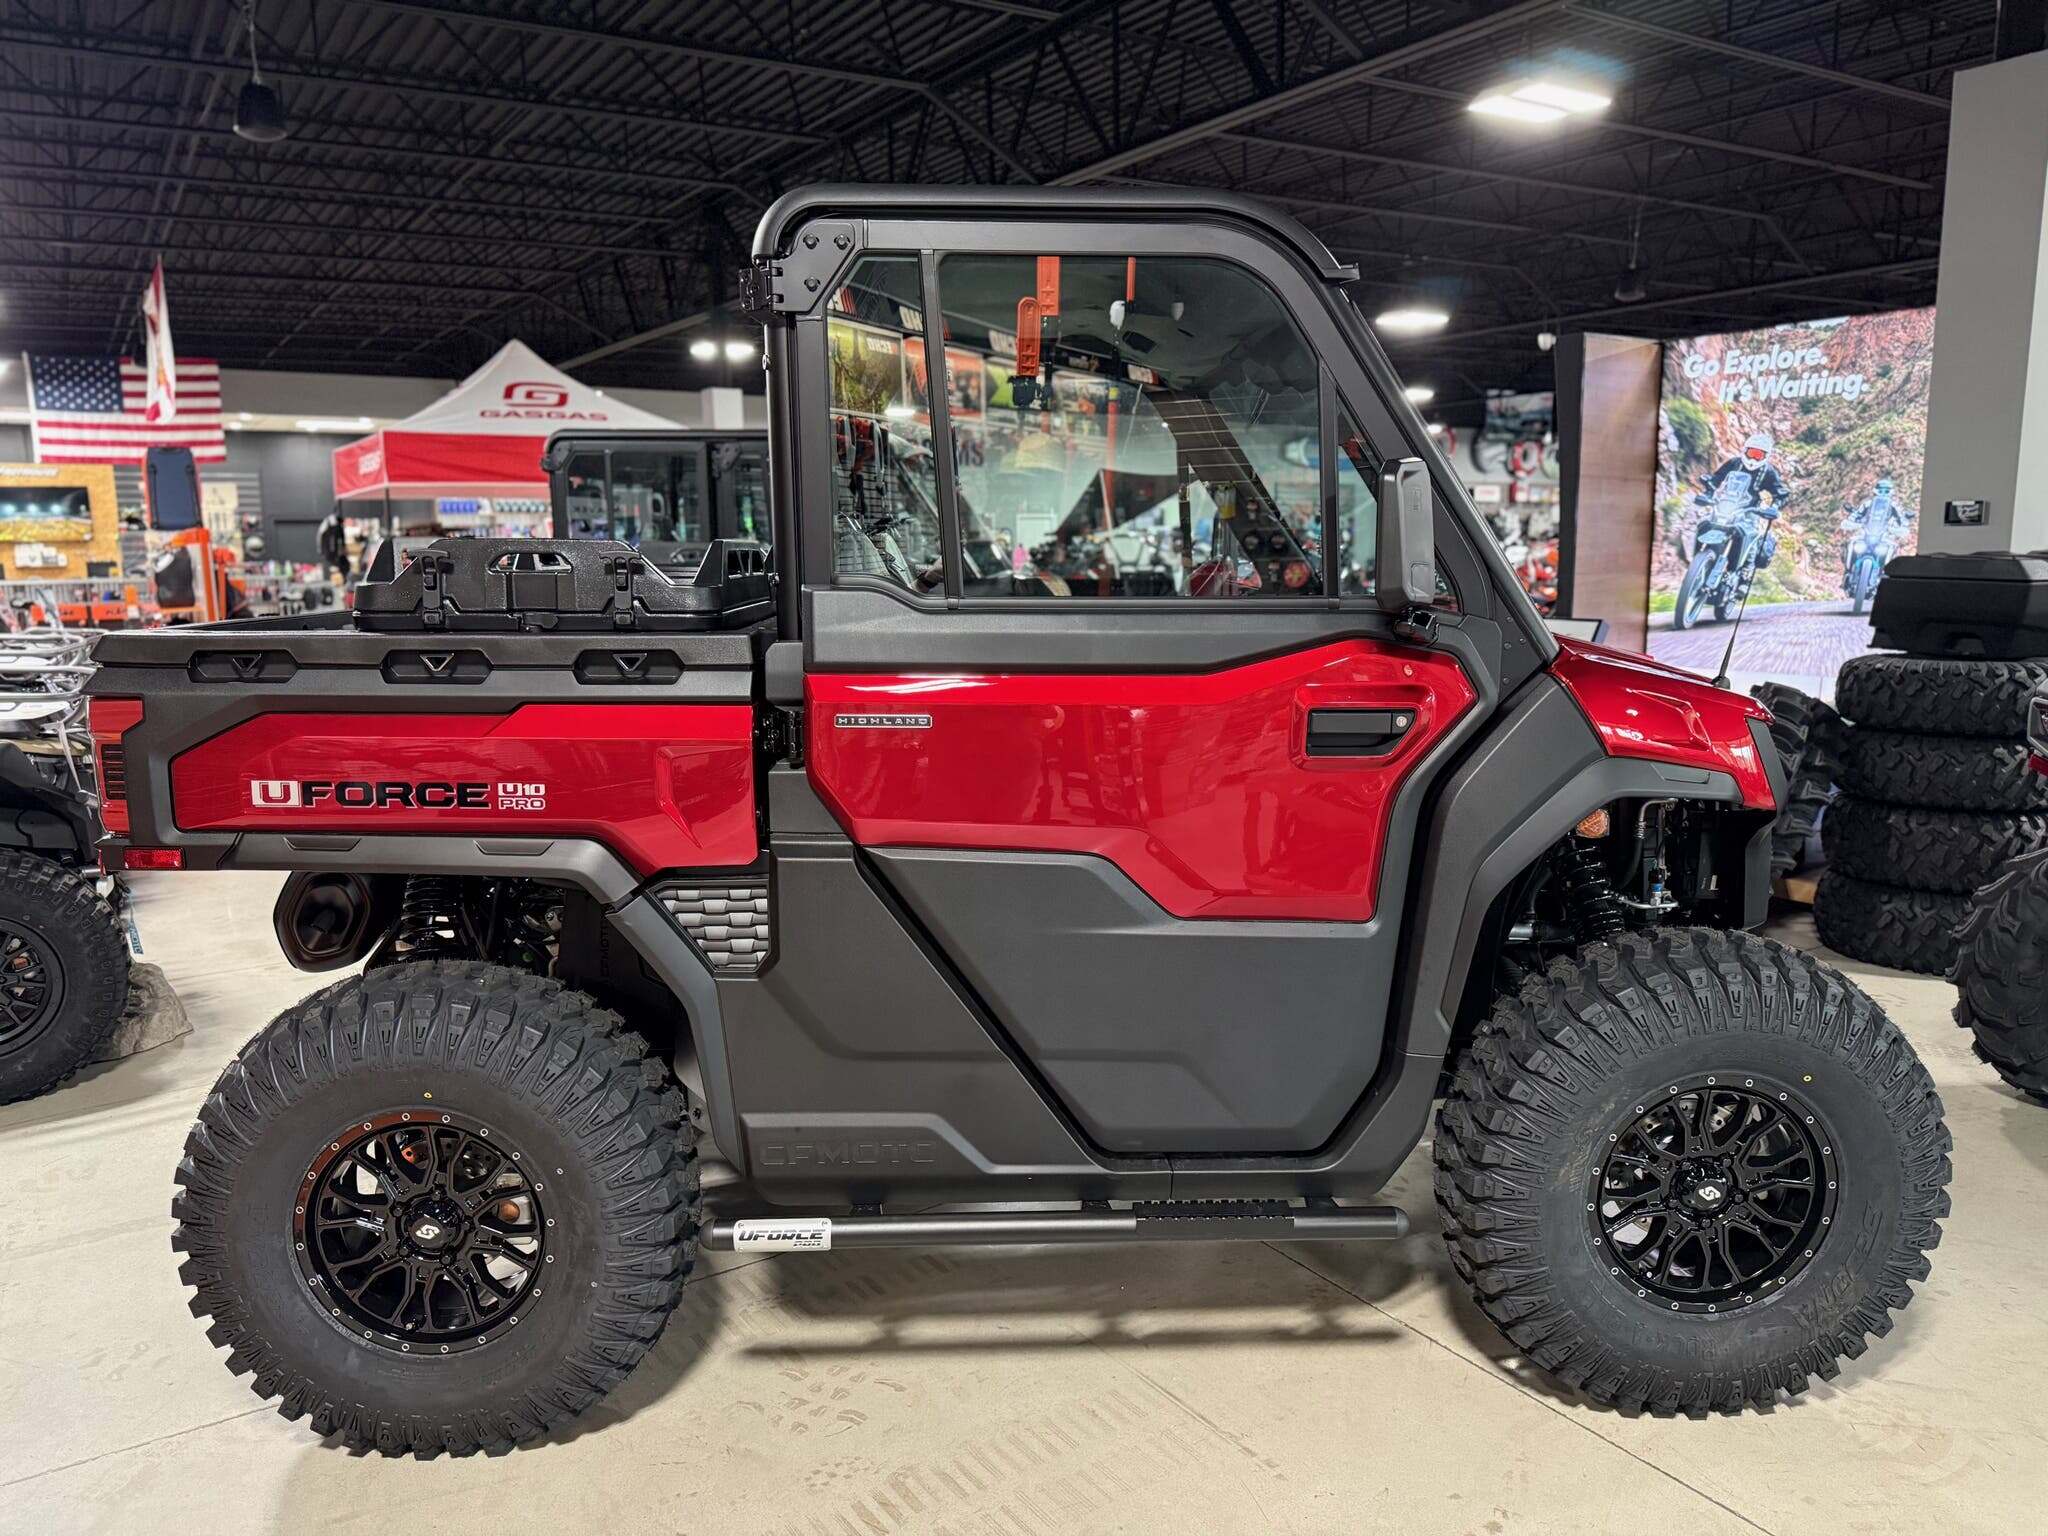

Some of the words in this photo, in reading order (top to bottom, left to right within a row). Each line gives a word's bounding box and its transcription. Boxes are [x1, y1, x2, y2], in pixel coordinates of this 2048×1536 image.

[1683, 354, 1720, 378] Go
[1723, 344, 1828, 377] Explore.
[1718, 378, 1753, 403] It's
[1757, 370, 1869, 400] Waiting.
[479, 409, 608, 422] GASGAS
[837, 717, 929, 726] HIGHLAND
[497, 783, 545, 796] U10
[497, 798, 546, 810] PRO
[739, 1229, 826, 1241] UFORCE
